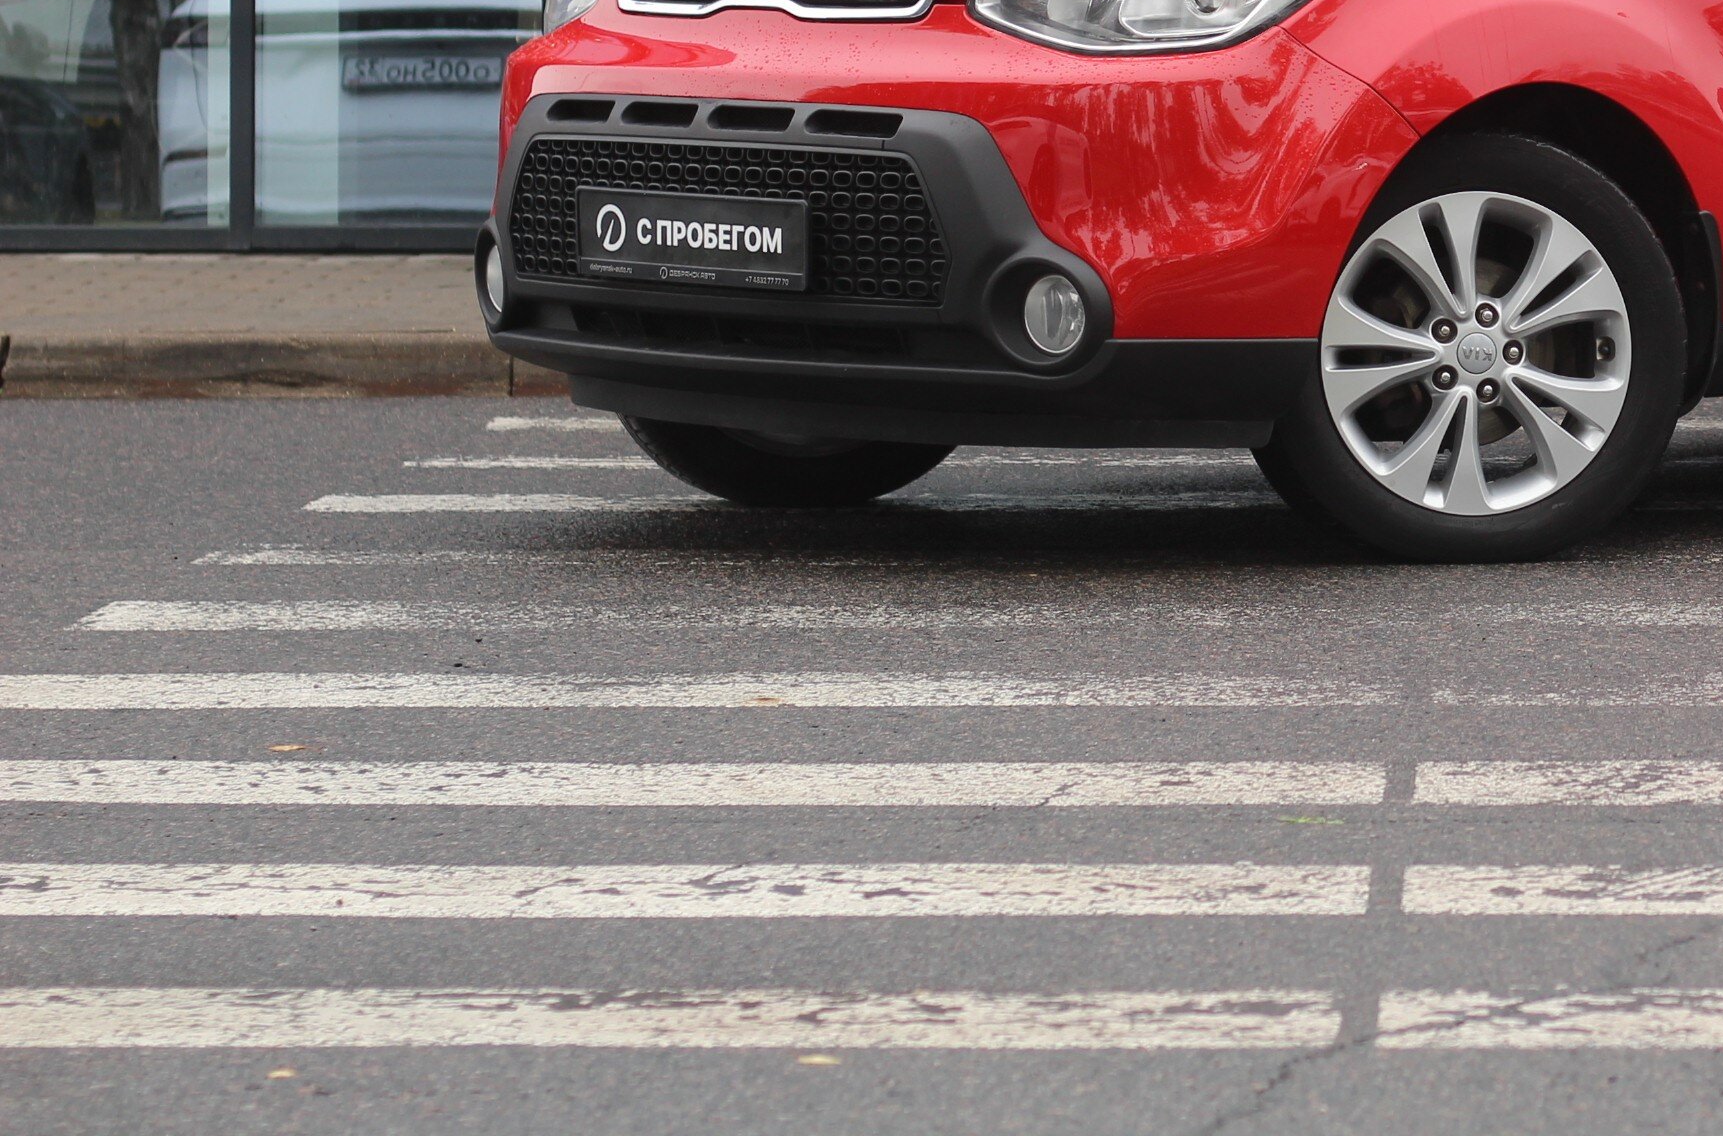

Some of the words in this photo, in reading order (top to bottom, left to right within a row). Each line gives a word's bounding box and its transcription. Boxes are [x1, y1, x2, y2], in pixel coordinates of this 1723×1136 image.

[636, 217, 653, 245] С
[656, 219, 783, 255] ПРОБЕГОМ
[1461, 345, 1493, 362] KIA
